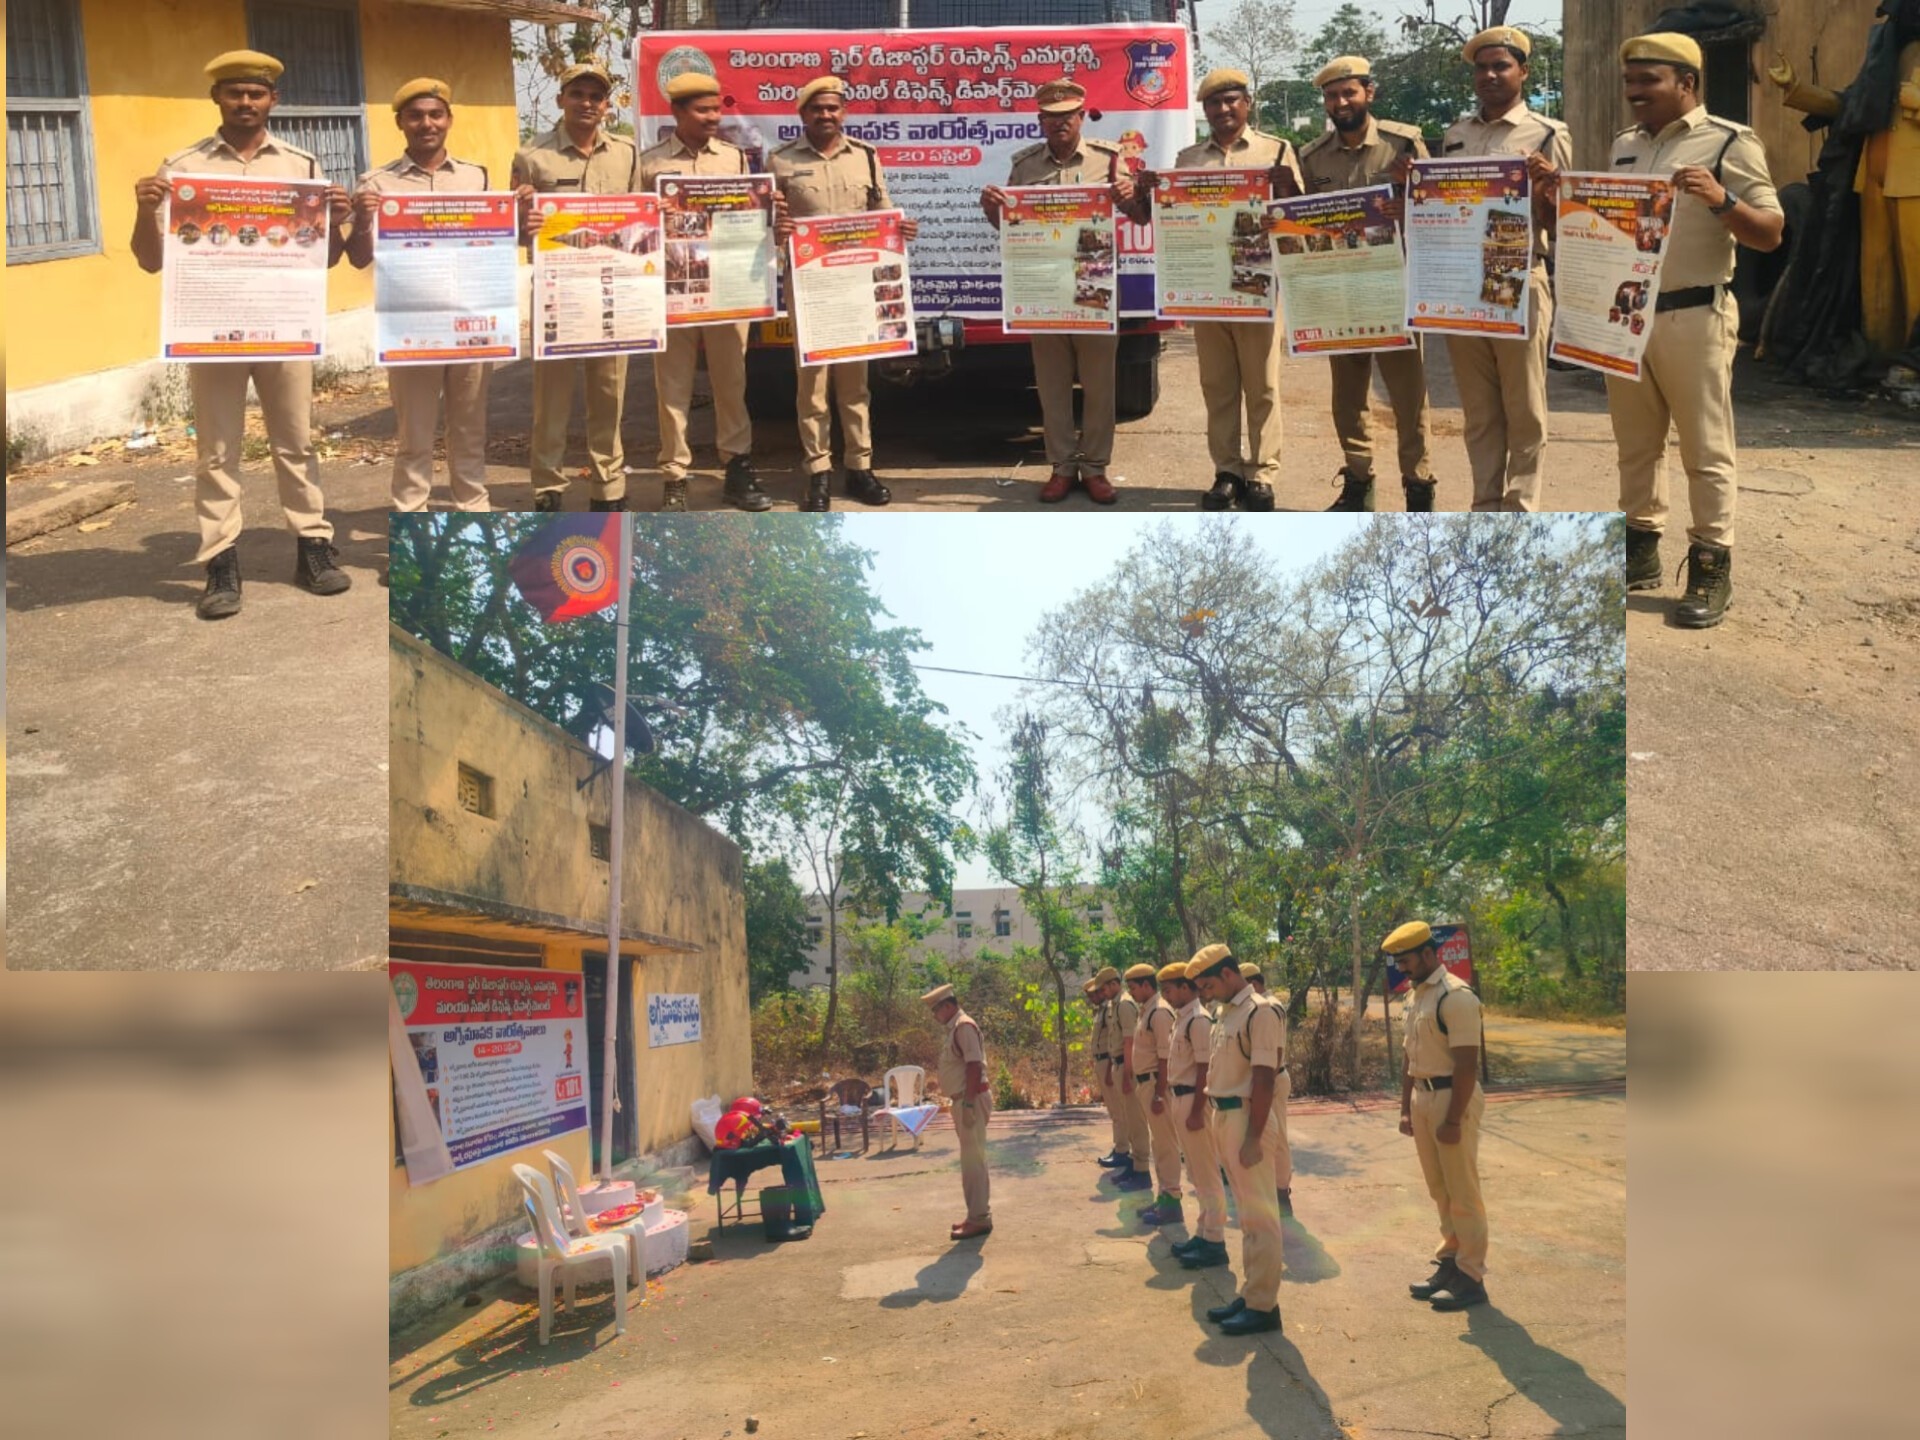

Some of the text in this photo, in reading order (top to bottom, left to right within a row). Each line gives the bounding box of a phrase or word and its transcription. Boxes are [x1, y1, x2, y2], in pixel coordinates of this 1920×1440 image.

[729, 43, 1101, 77] తెలంగాణ ఫైర్ డిజాస్టర్ రెస్పాన్స్ ఎమర్జెన్సీ
[893, 79, 953, 106] డిఫెన్స్
[956, 79, 1039, 107] డిపార్ట్‌మె
[897, 150, 925, 163] 20
[929, 149, 973, 166] ఏప్రిల్
